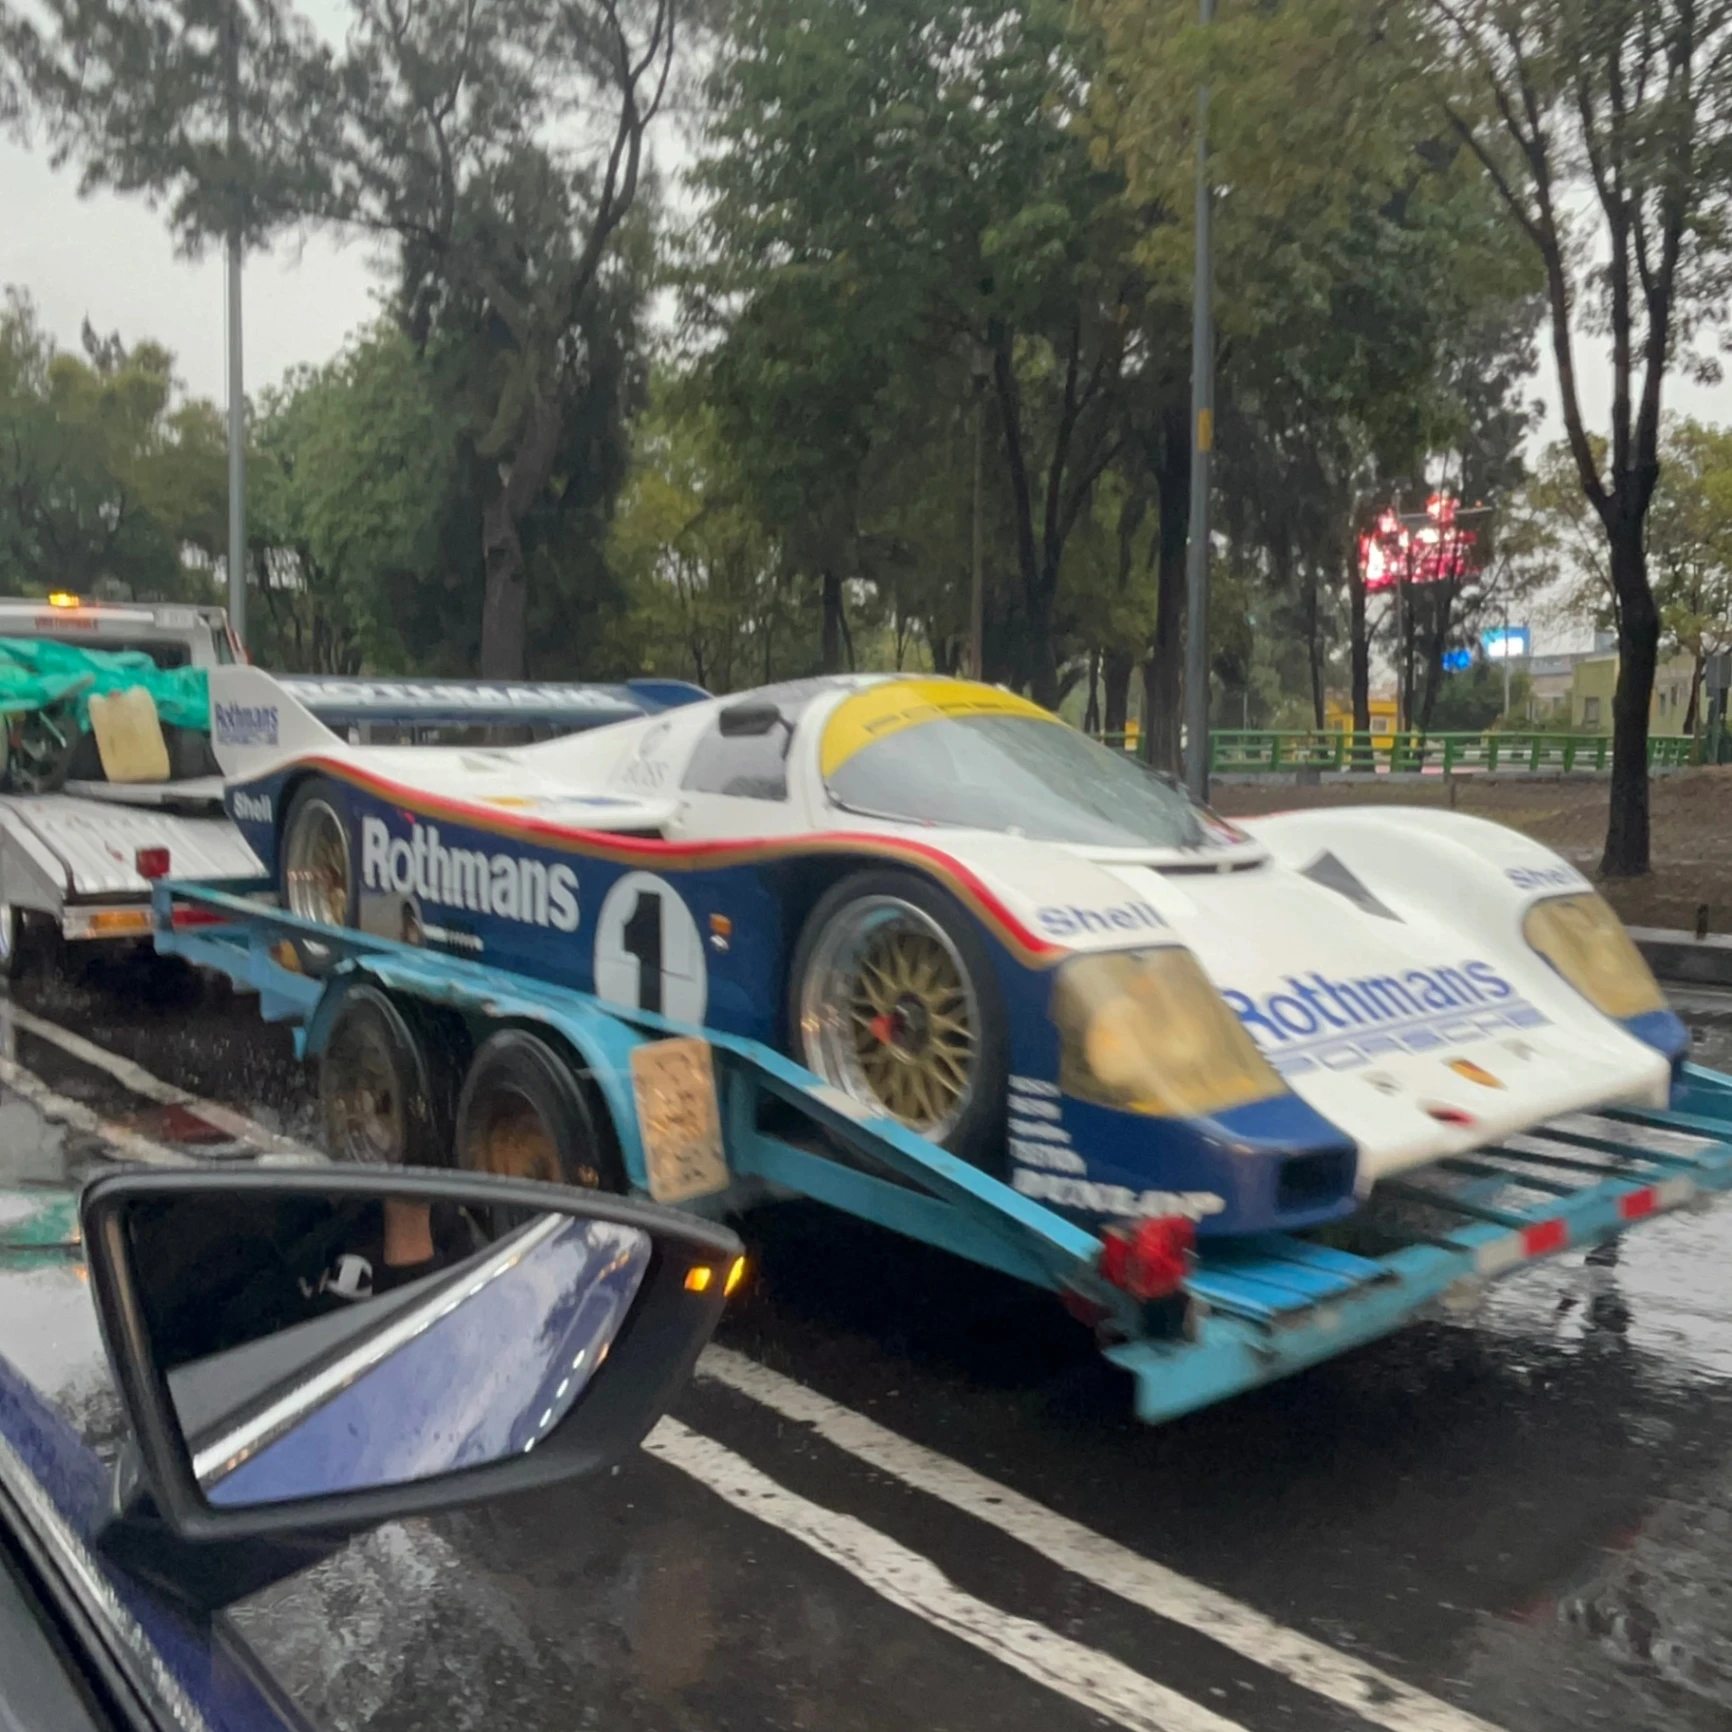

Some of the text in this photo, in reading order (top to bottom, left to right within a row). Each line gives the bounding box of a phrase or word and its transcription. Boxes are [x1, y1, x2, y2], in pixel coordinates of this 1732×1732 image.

[233, 791, 273, 823] Shell
[361, 815, 580, 933] Rothmans
[623, 890, 662, 1013] 1
[1037, 900, 1172, 936] Shell
[1221, 960, 1513, 1041] Rothmans
